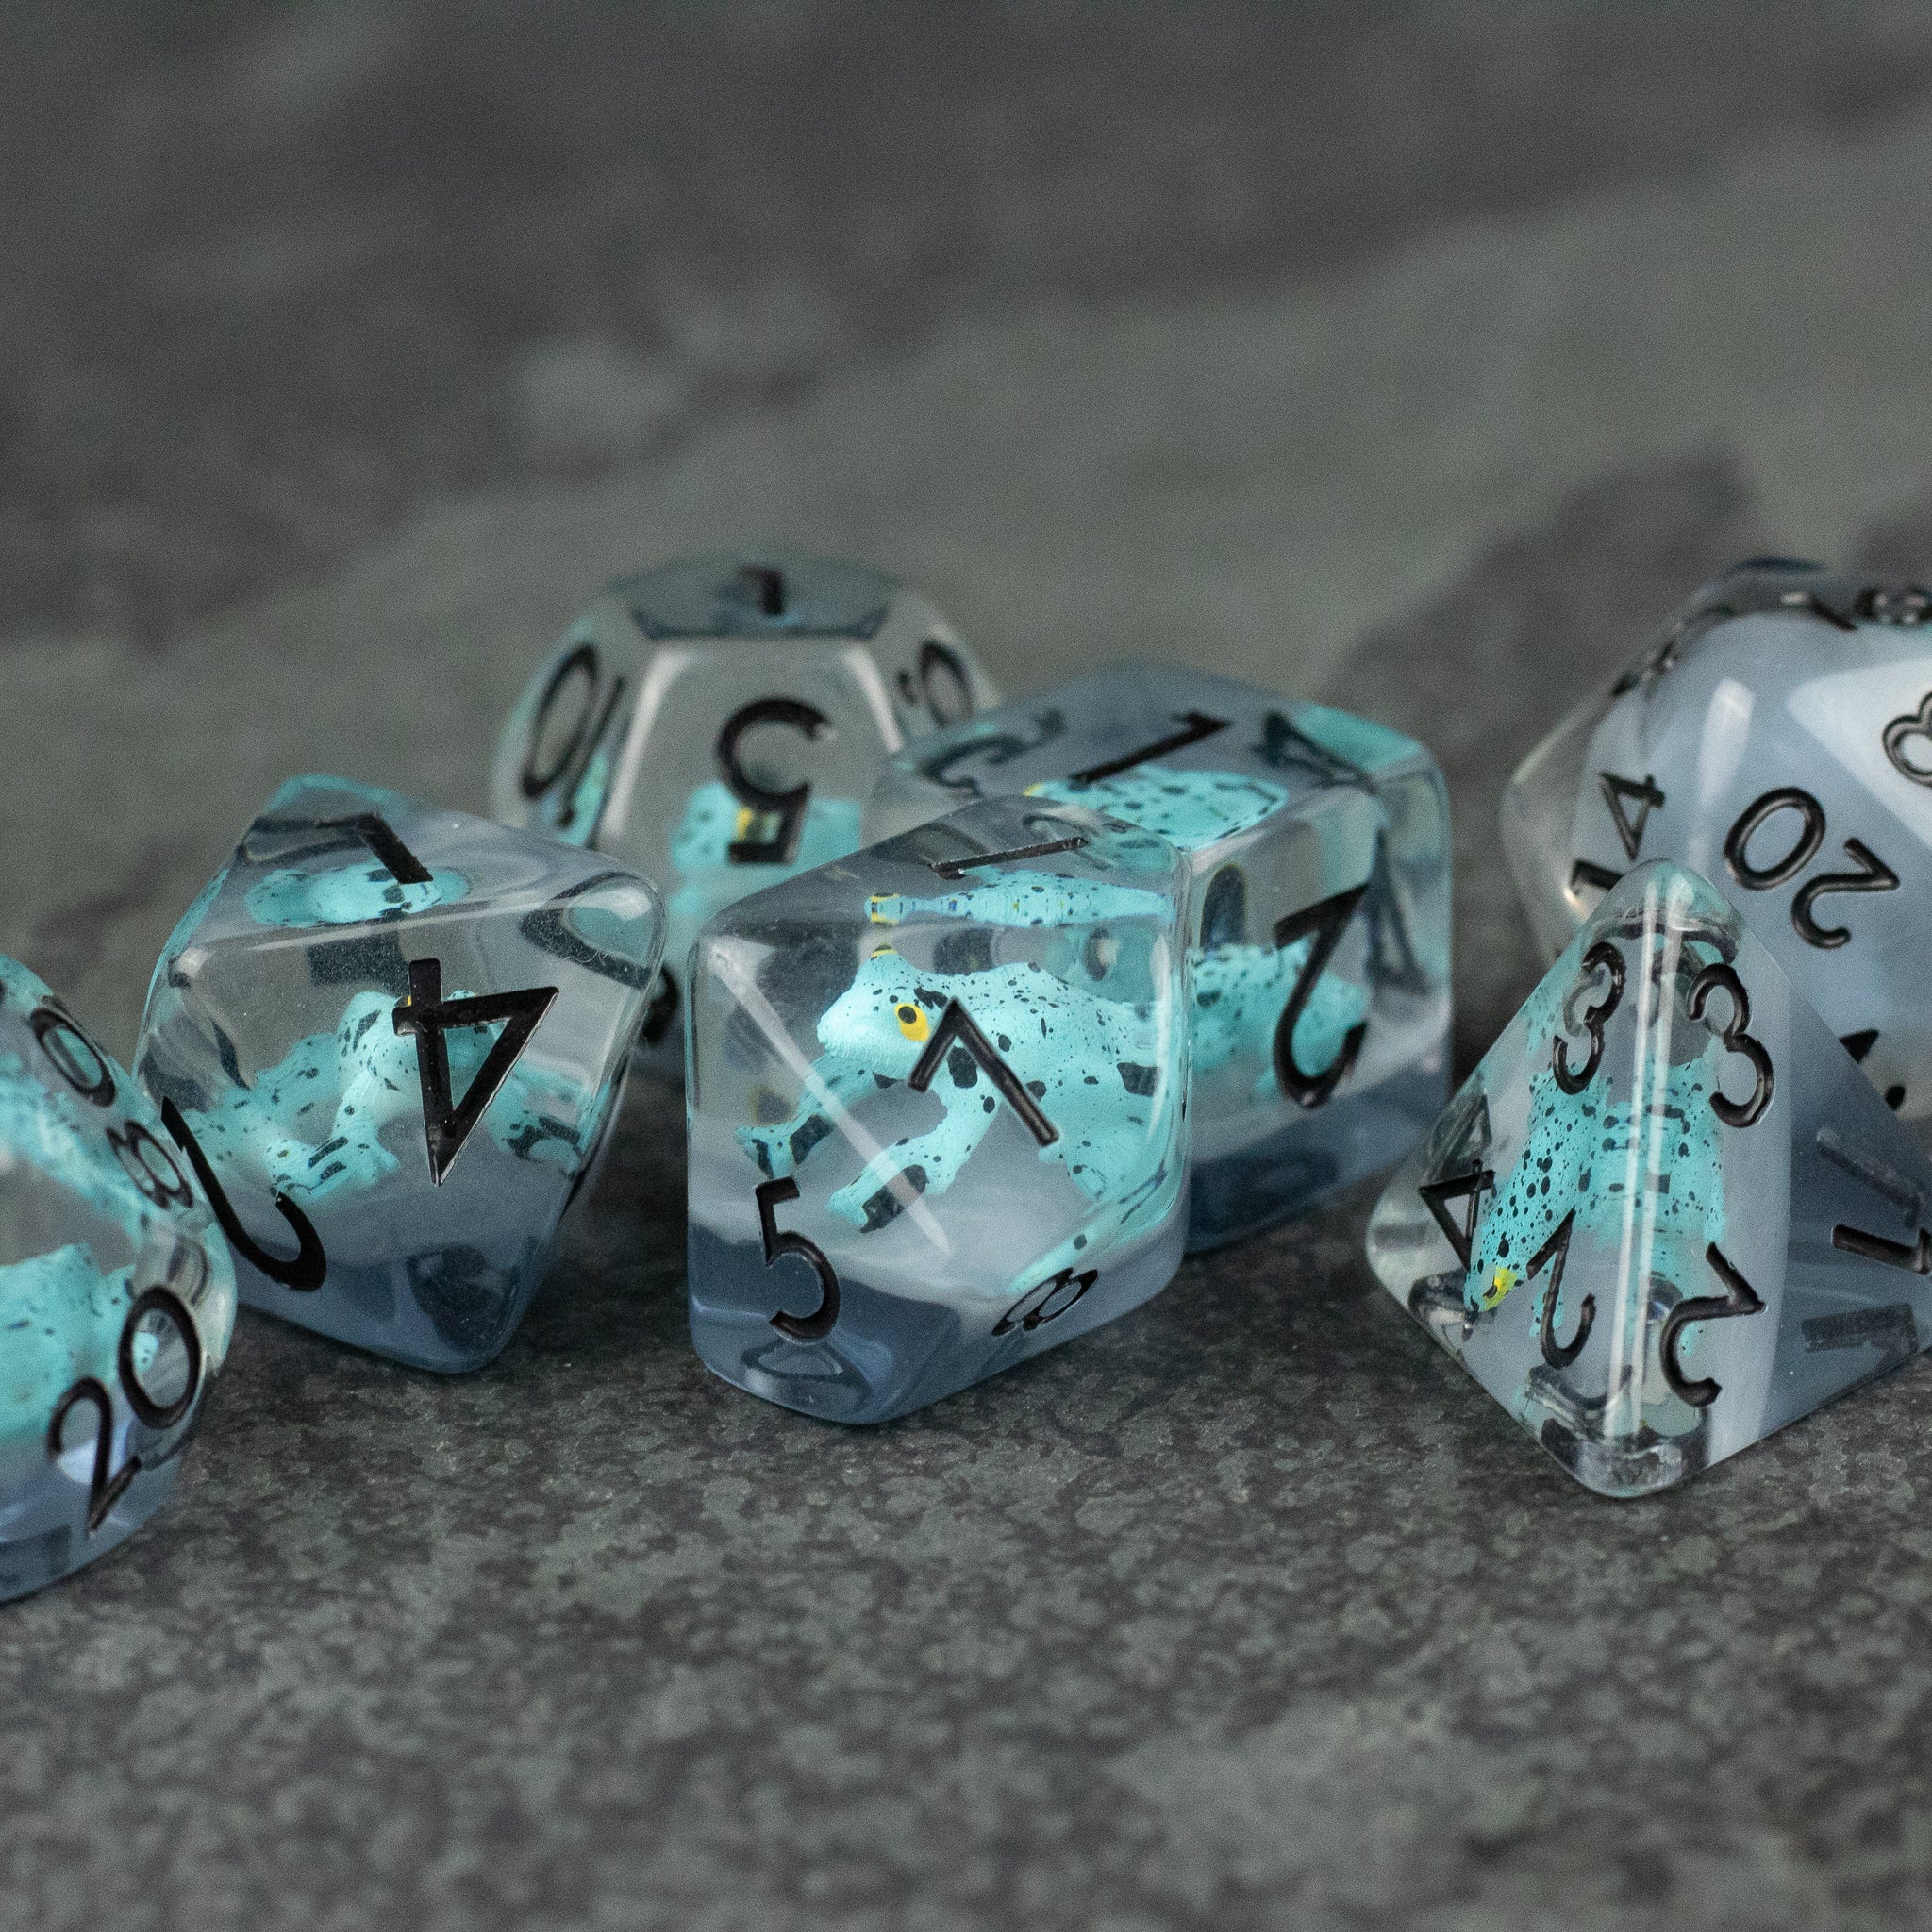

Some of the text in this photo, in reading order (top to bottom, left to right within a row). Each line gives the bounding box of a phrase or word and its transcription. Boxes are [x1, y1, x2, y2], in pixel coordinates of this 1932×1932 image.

[718, 697, 834, 864] 5
[1724, 787, 1900, 949] 20
[391, 958, 560, 1187] 4
[1274, 882, 1371, 1108] 2
[1557, 941, 1626, 1094] 3
[1689, 963, 1774, 1127] 3
[754, 1175, 841, 1344] 5
[1418, 1158, 1494, 1272] 4
[1526, 1210, 1596, 1368] 2
[991, 1267, 1099, 1338] 8
[1658, 1241, 1767, 1406] 2
[46, 1285, 202, 1536] 20
